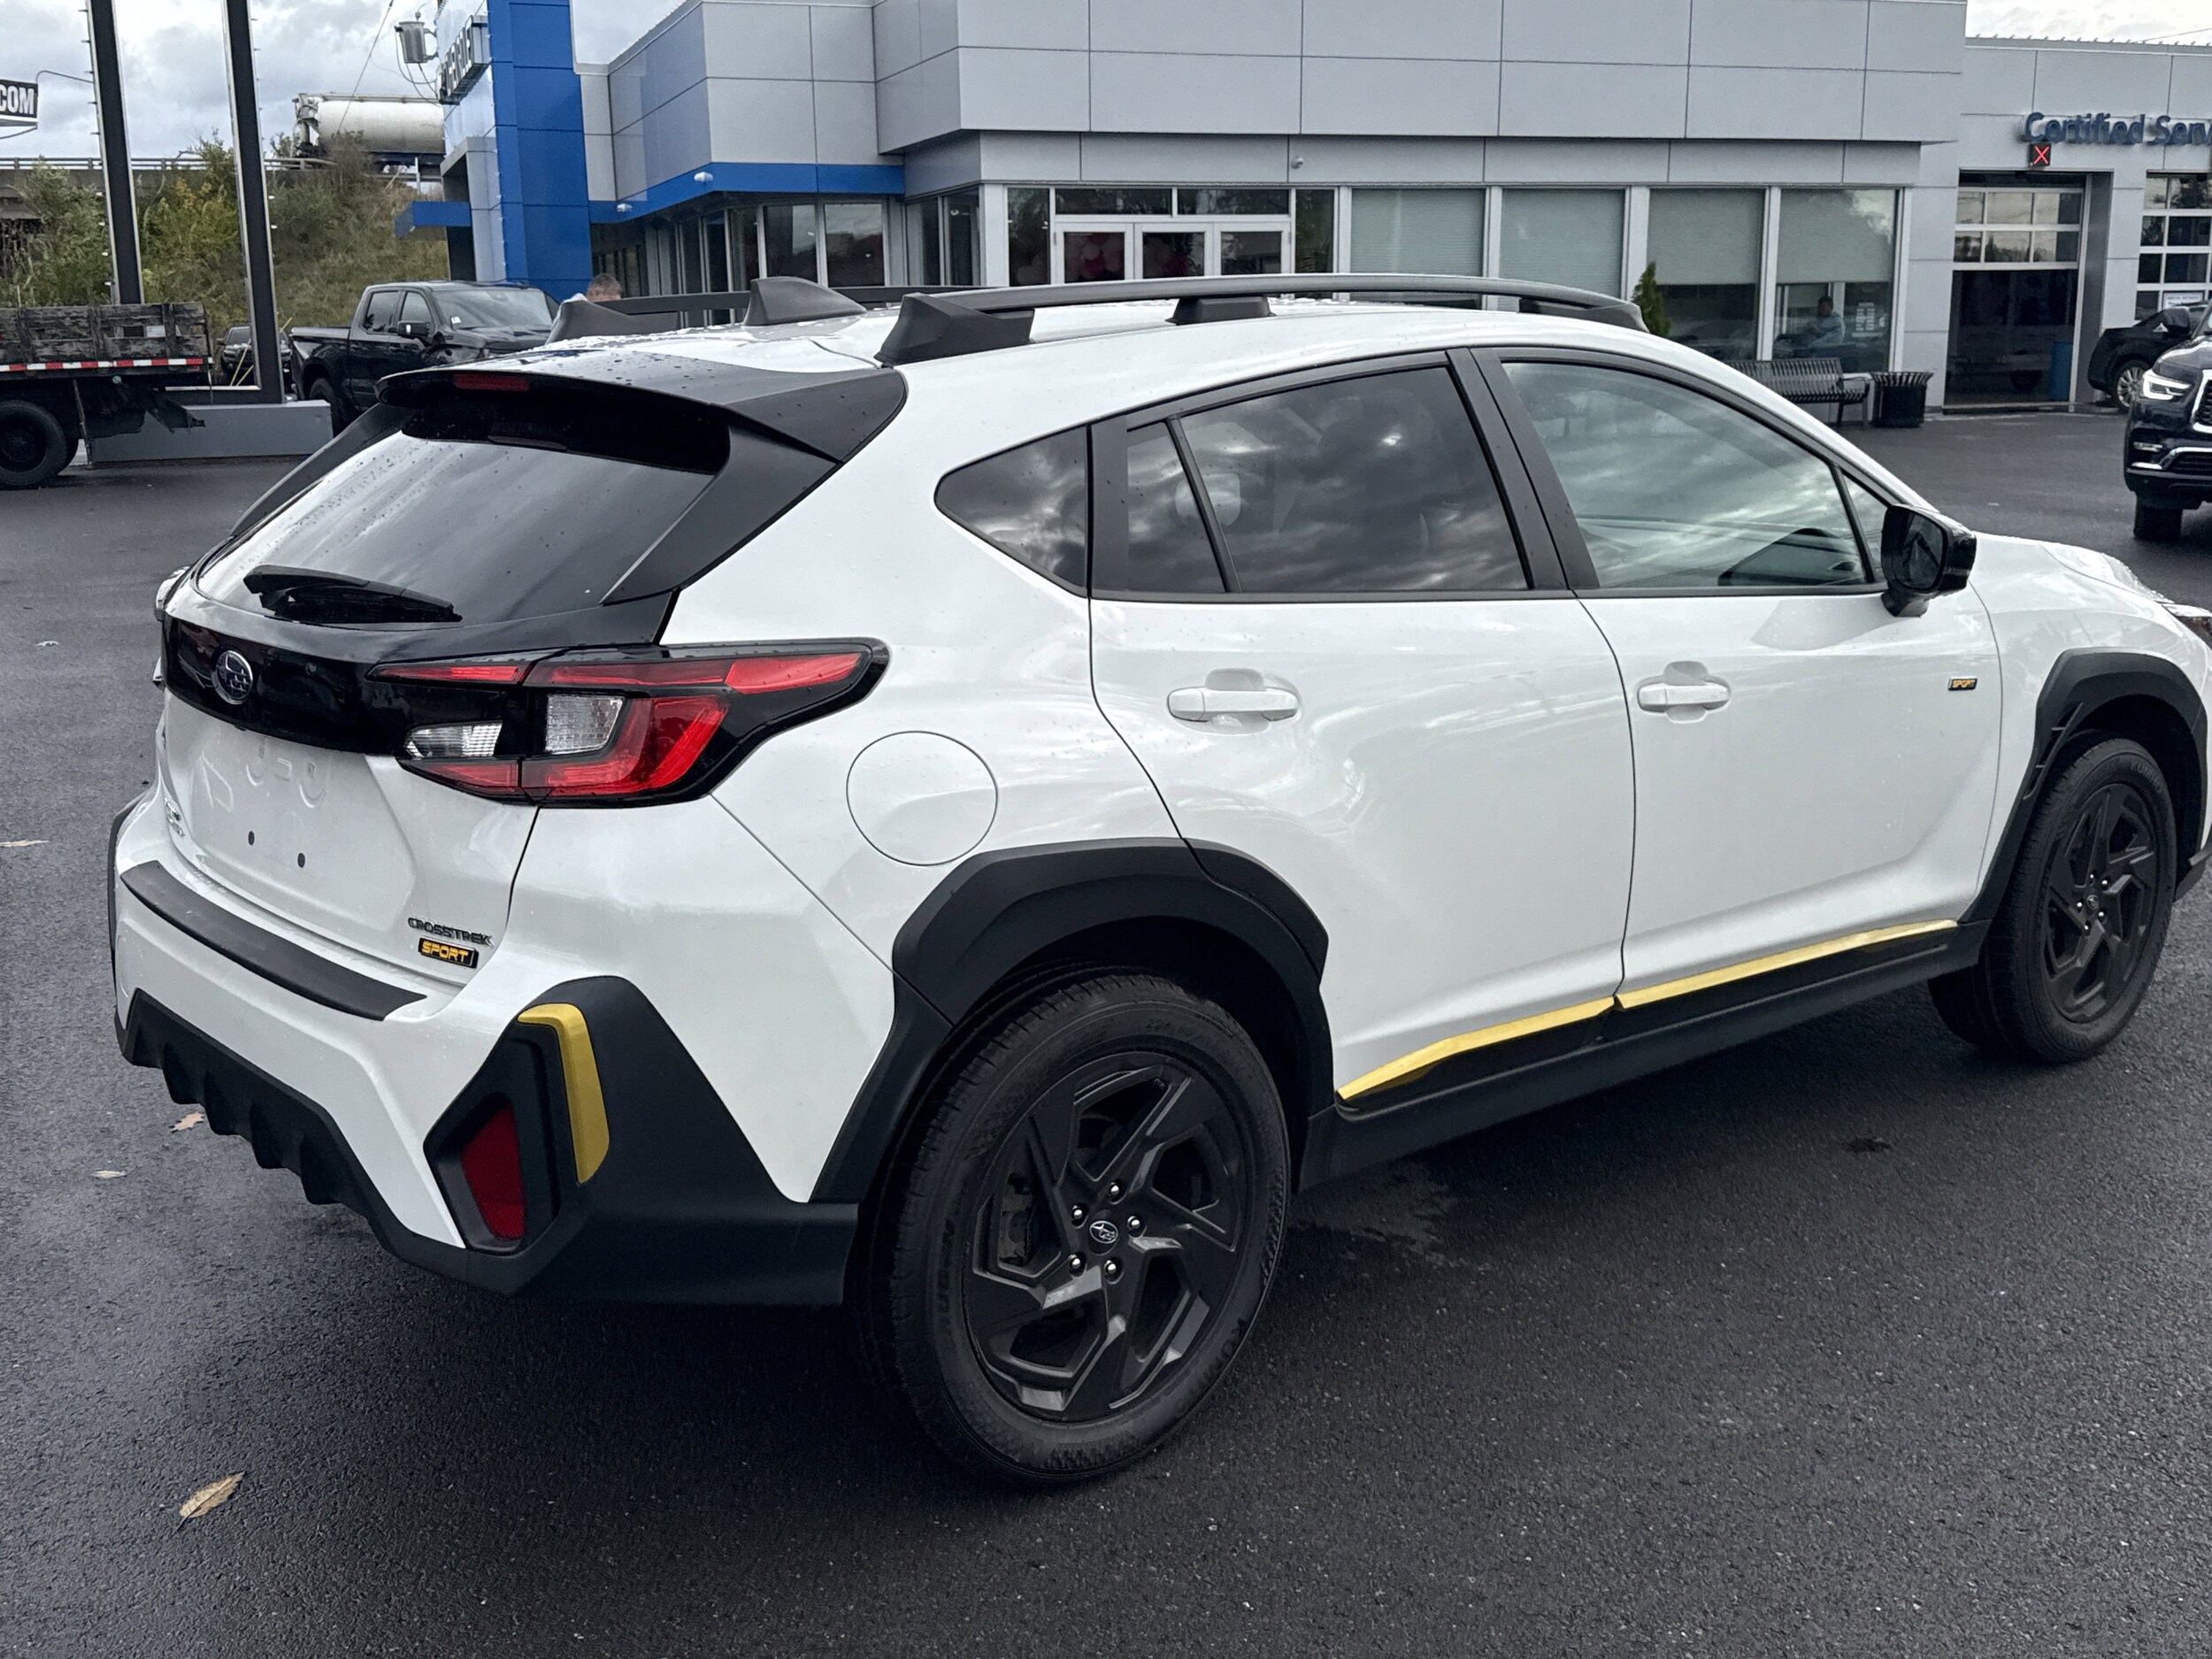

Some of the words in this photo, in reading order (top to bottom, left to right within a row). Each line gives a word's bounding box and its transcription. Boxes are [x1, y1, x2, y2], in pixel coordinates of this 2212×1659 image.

[2025, 111, 2146, 145] Certified
[408, 917, 493, 947] CROSSTREK
[421, 941, 469, 963] SPORT
